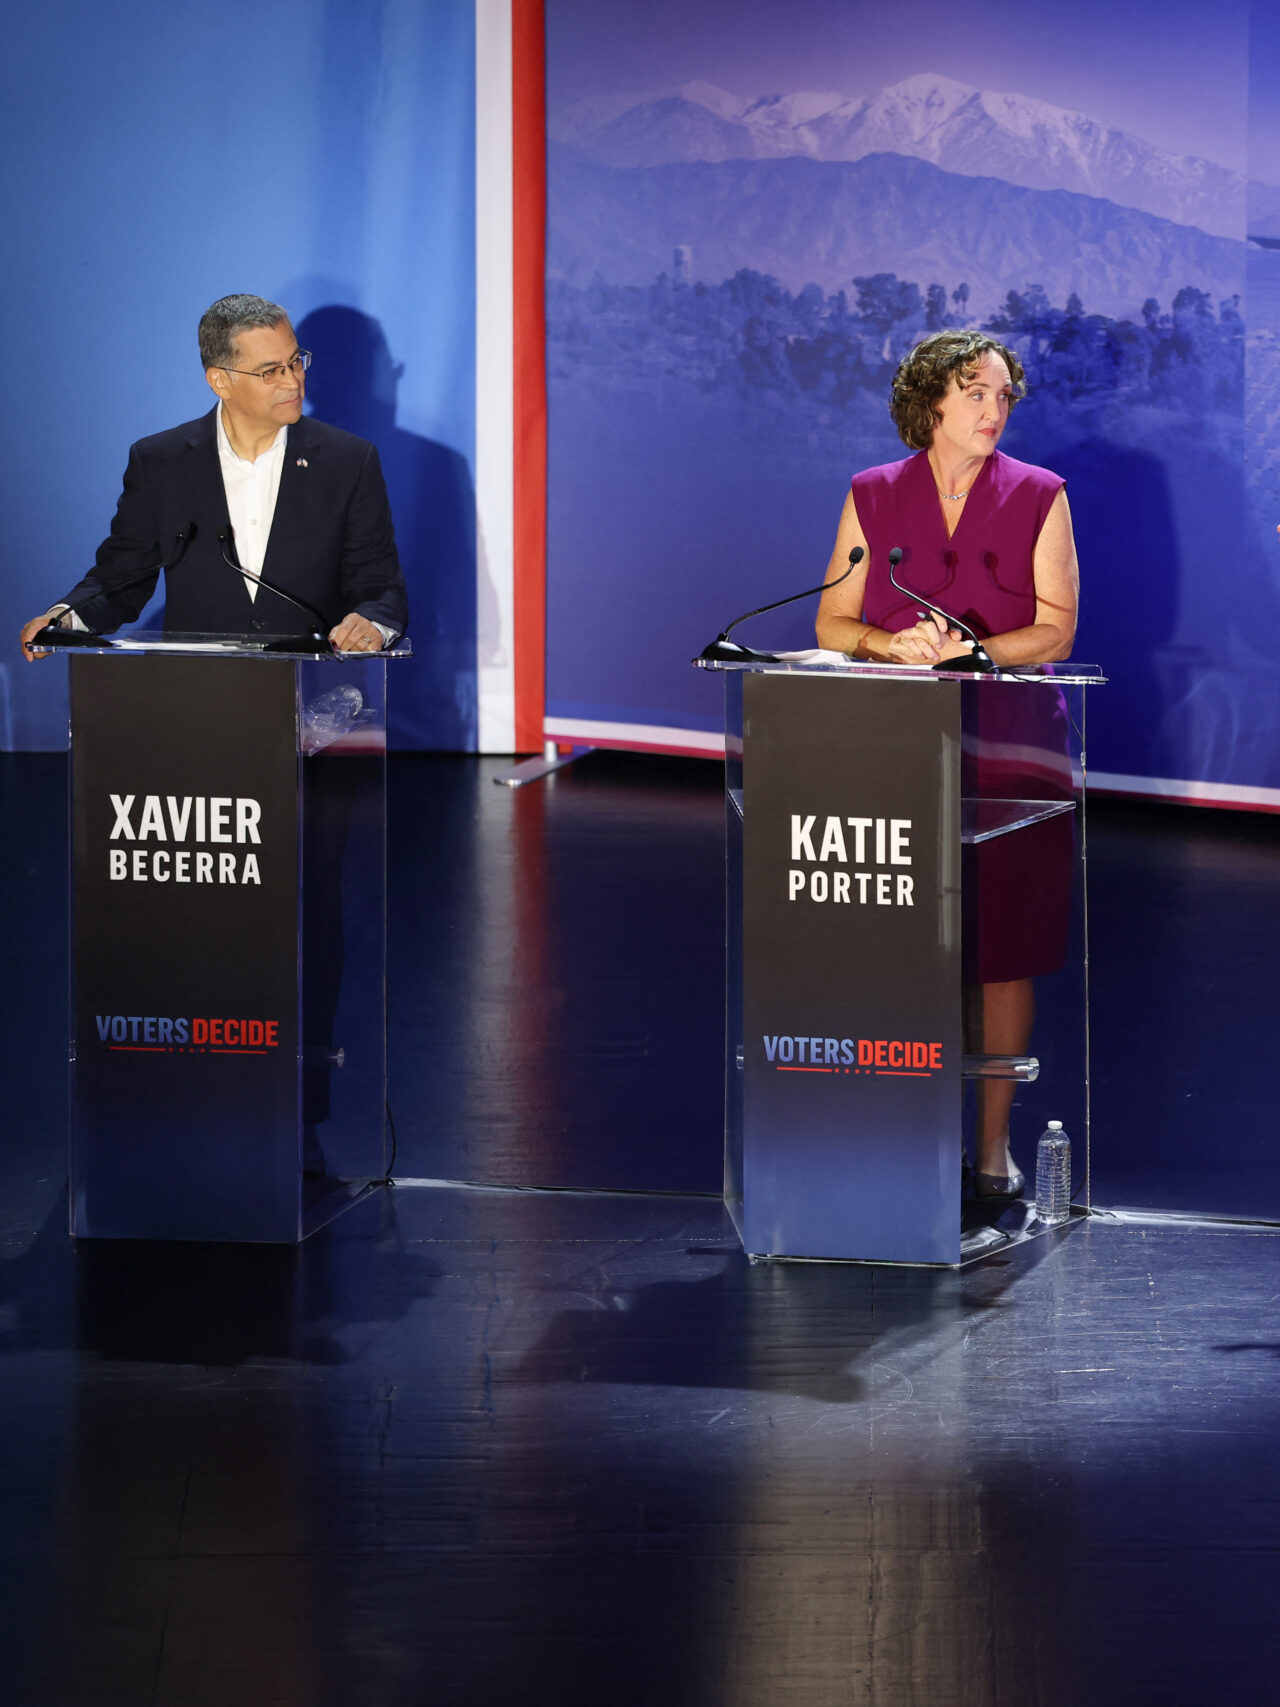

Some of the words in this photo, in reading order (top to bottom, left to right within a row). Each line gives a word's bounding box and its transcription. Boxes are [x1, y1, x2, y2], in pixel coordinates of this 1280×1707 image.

[110, 795, 261, 843] XAVIER
[792, 815, 911, 865] KATIE
[110, 850, 261, 884] BECERRA
[789, 870, 914, 906] PORTER
